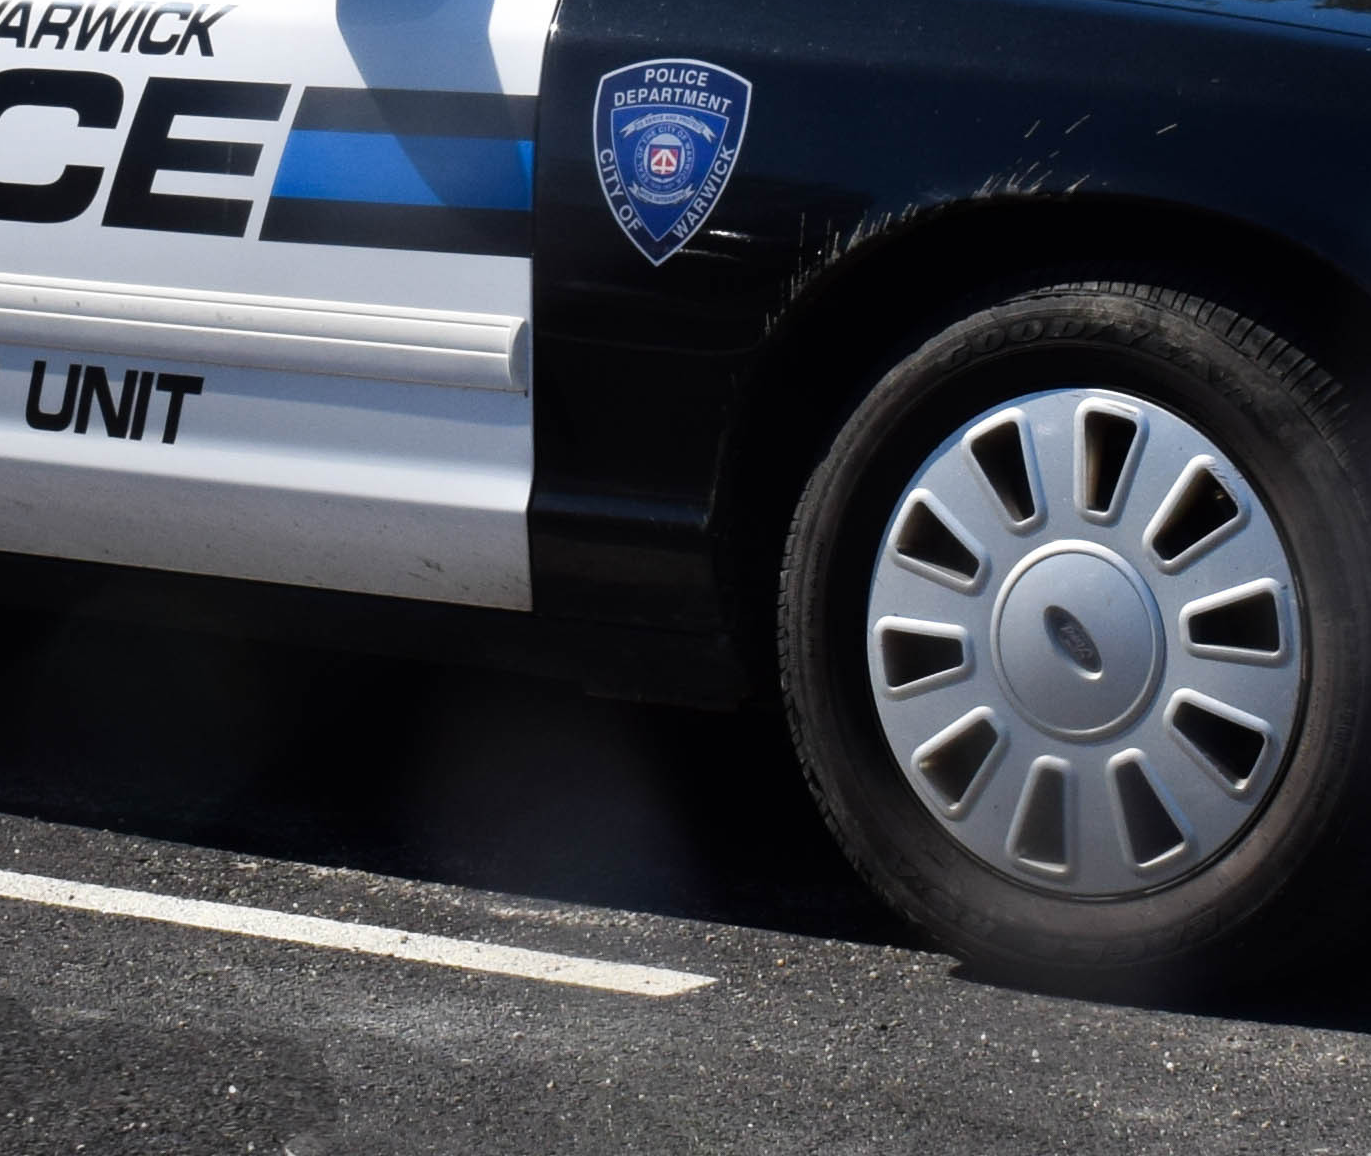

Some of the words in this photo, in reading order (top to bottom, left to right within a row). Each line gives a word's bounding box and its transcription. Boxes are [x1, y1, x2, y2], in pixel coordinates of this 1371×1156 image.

[614, 87, 732, 114] DEPARTMENT
[644, 68, 709, 87] POLICE
[599, 148, 624, 198] CITY
[618, 204, 642, 231] OF
[673, 144, 735, 239] WARWICK
[25, 360, 205, 445] UNIT
